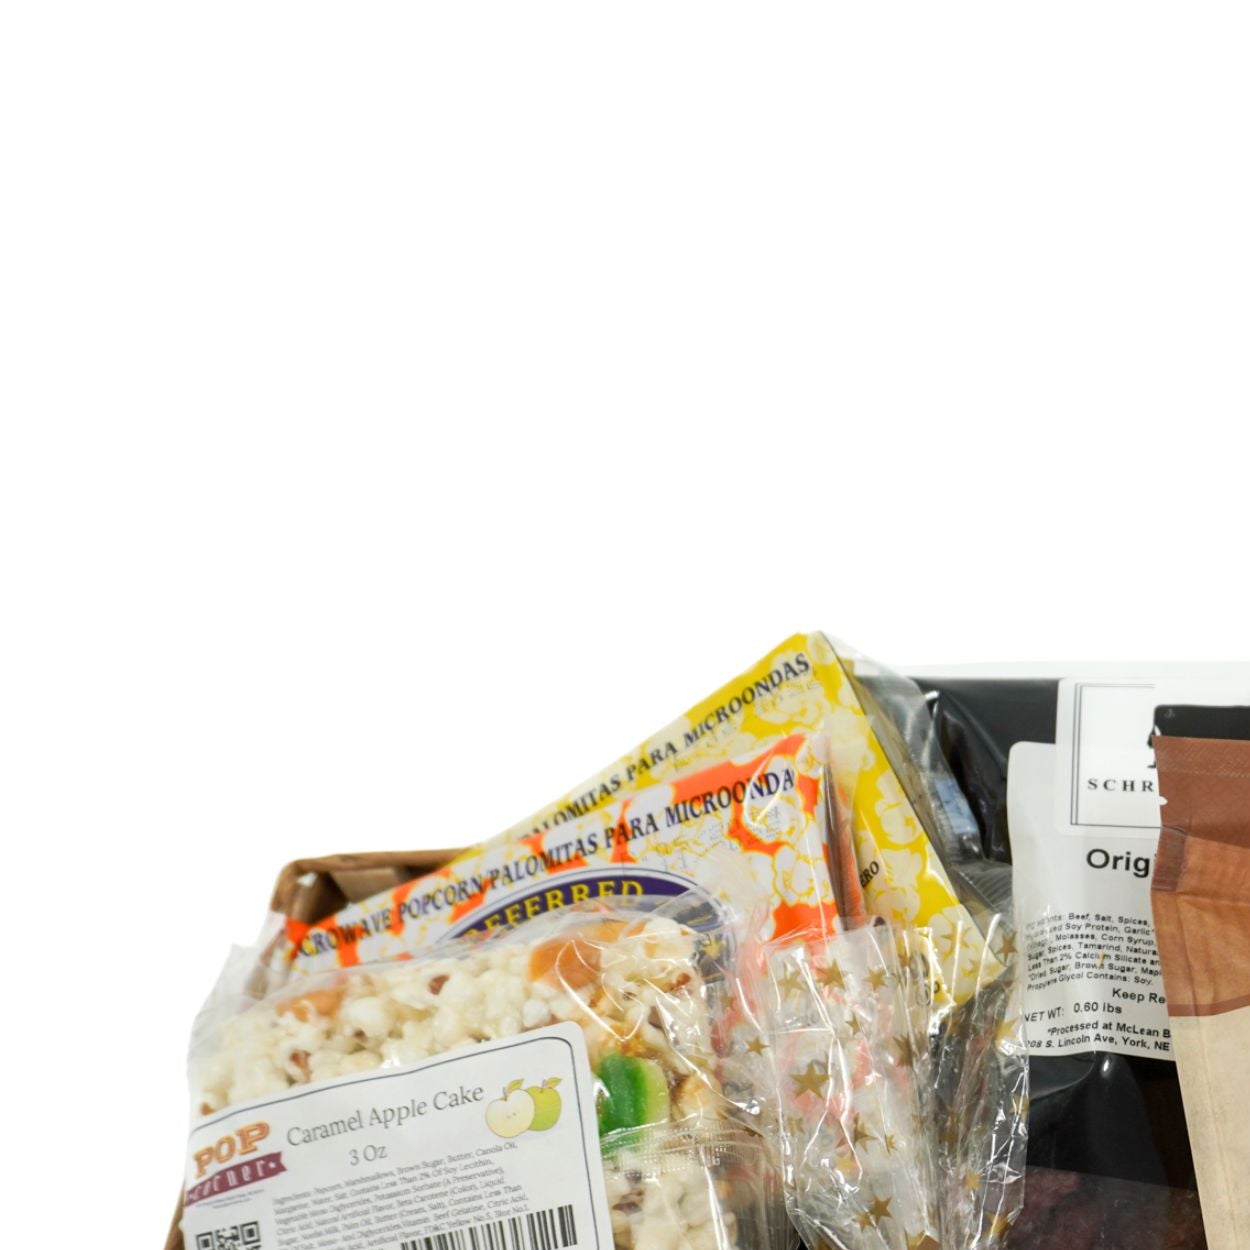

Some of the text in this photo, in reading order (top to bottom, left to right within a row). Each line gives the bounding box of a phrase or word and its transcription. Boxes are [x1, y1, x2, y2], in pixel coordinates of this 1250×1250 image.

[626, 741, 678, 780] PARA
[683, 652, 811, 747] MICROONDAS
[399, 873, 485, 921] POPCORN
[488, 832, 599, 892] PALOMITAS
[604, 812, 660, 849] PARA
[1065, 923, 1081, 931] Soy
[1085, 922, 1120, 933] Protein,
[1118, 916, 1150, 926] Spices,
[1059, 953, 1072, 961] 2%
[1115, 954, 1146, 963] Silicate
[1059, 972, 1083, 983] Glycol
[1112, 988, 1145, 1003] Keep
[1048, 1007, 1064, 1019] WT:
[1074, 1002, 1098, 1014] 0.60
[1103, 1003, 1122, 1014] lbs
[1116, 1023, 1159, 1037] McLean
[1059, 1034, 1090, 1047] Lincoln
[1094, 1033, 1118, 1045] Ave,
[1122, 1036, 1150, 1049] York,
[1154, 1041, 1170, 1051] NE
[286, 1085, 484, 1146] Caramel Apple Cake
[192, 1121, 271, 1178] POP
[349, 1144, 388, 1166] 3 Oz
